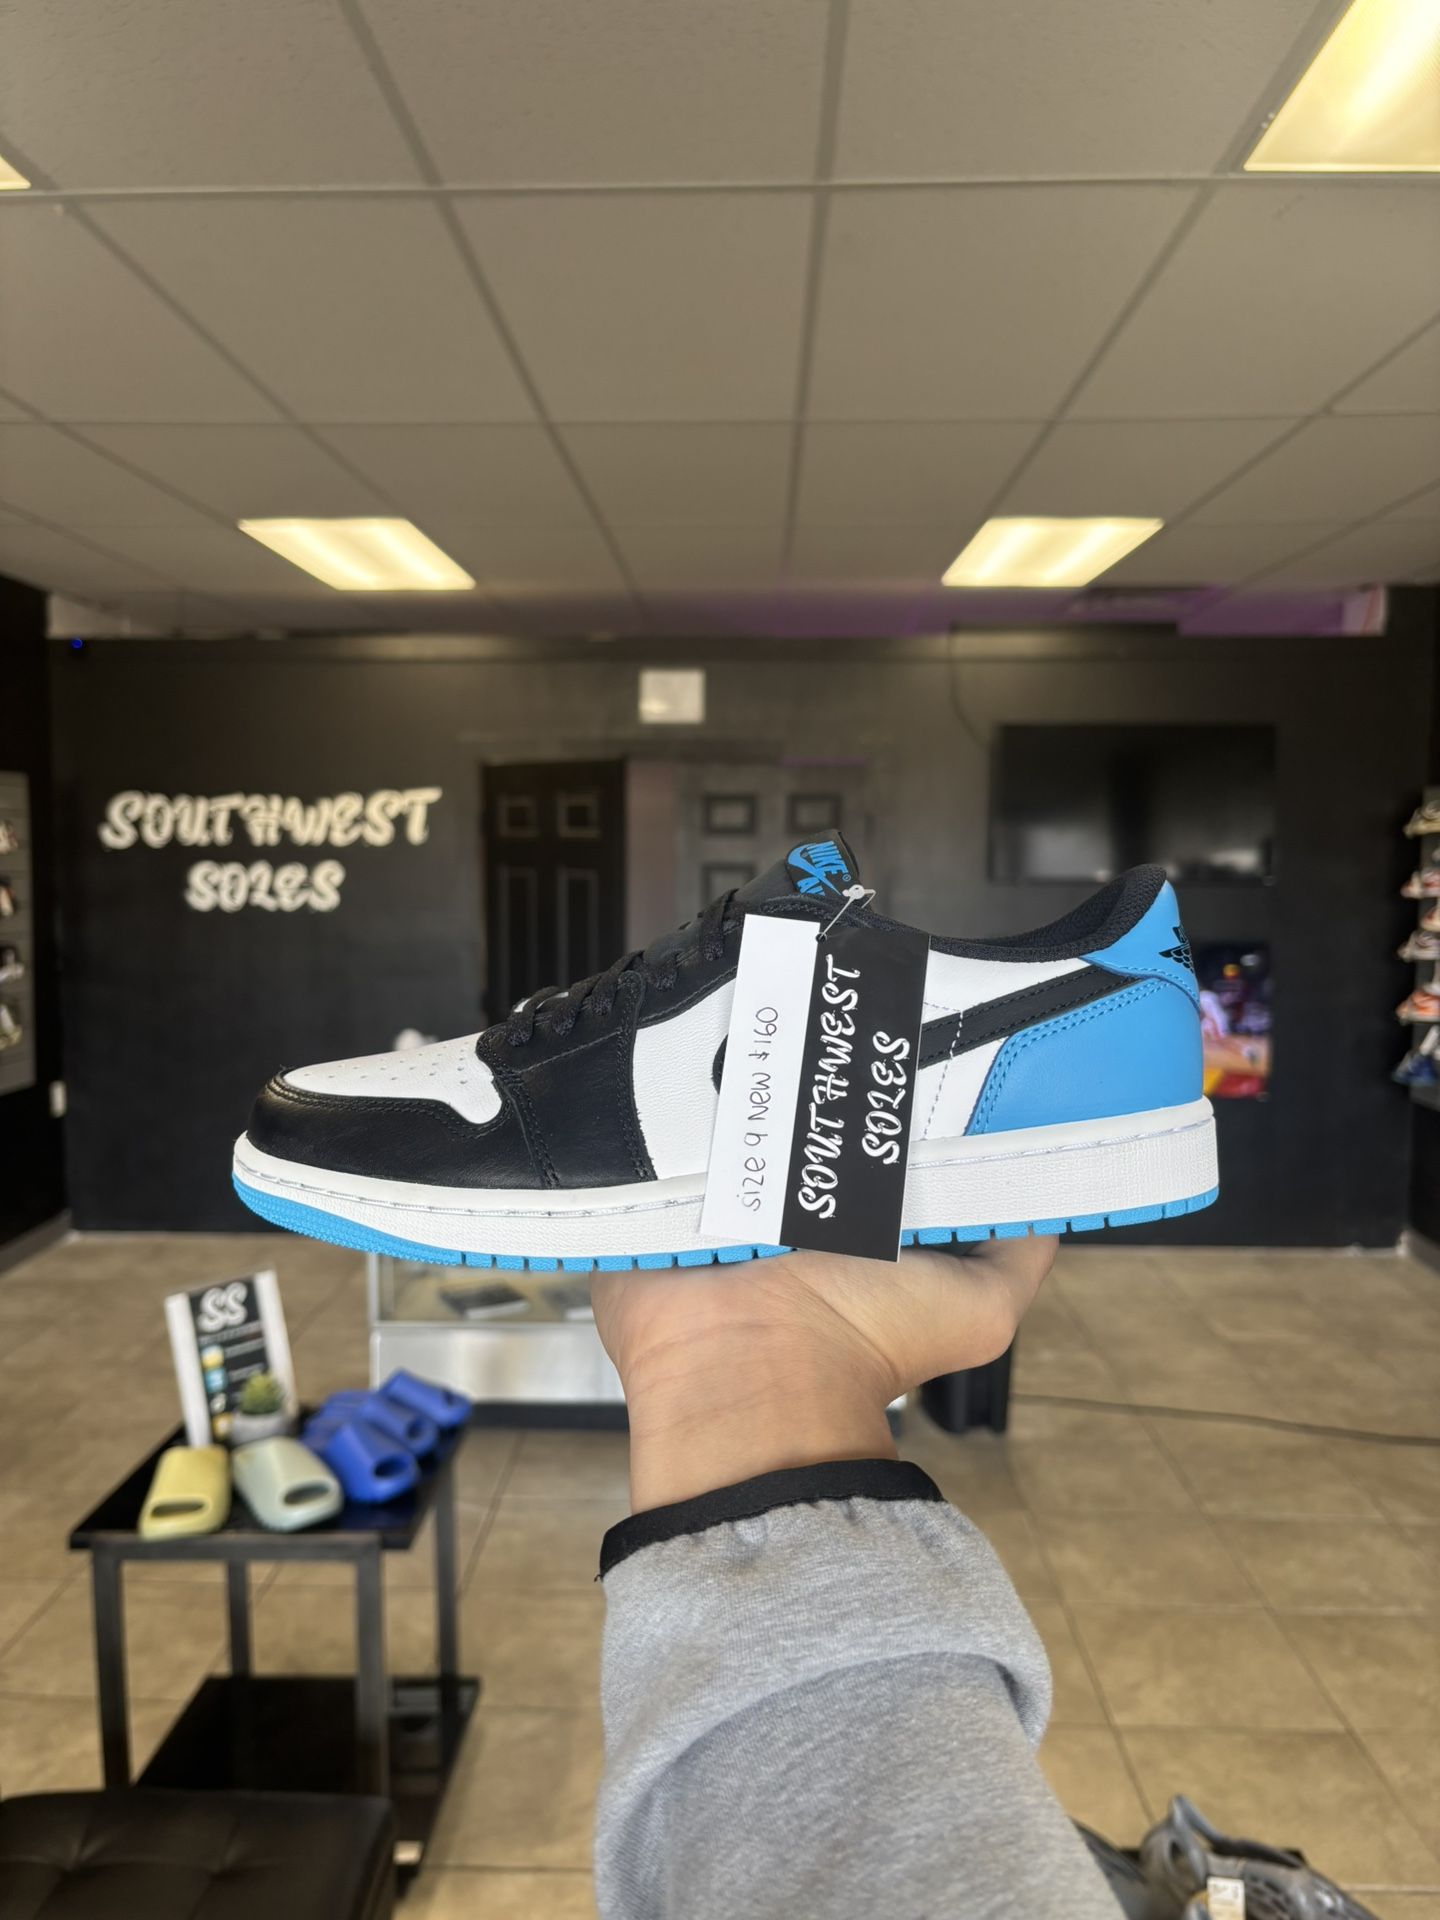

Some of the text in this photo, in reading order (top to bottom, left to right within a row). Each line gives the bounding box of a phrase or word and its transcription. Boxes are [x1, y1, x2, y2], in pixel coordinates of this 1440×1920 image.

[99, 787, 442, 849] SOUTHWEST
[806, 840, 849, 877] NIKE
[185, 860, 345, 912] SOLES
[748, 1006, 779, 1061] $160
[797, 953, 862, 1220] SOUTHWEST
[861, 1030, 911, 1166] SOLES
[743, 1131, 769, 1147] 9
[198, 1281, 248, 1333] SS
